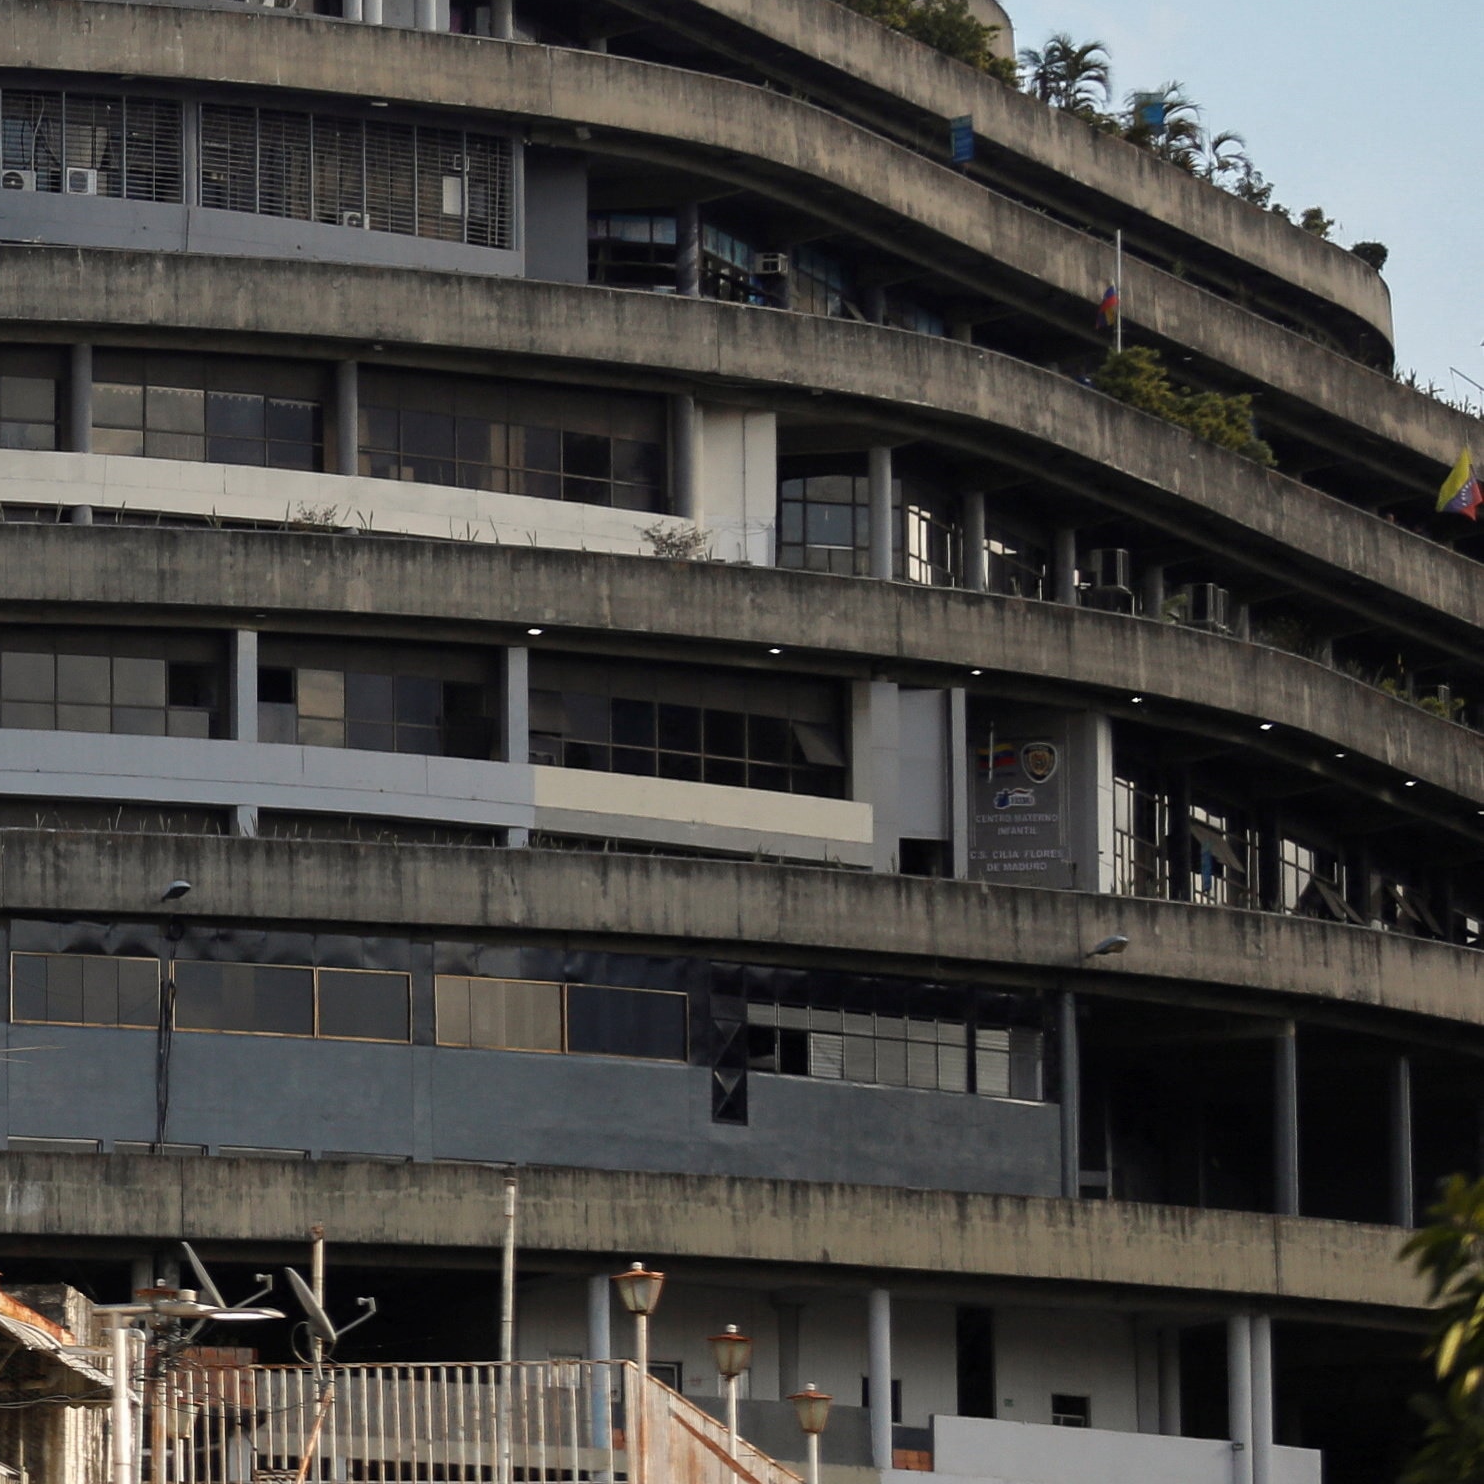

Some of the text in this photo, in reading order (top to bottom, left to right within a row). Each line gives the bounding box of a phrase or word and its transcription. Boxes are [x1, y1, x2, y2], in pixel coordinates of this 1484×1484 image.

[975, 815, 1014, 824] CENTRO
[997, 827, 1037, 836] INFANTIL
[992, 850, 1019, 859] CILIA
[1024, 849, 1064, 859] FLORES
[987, 862, 1048, 872] DE MADURO
